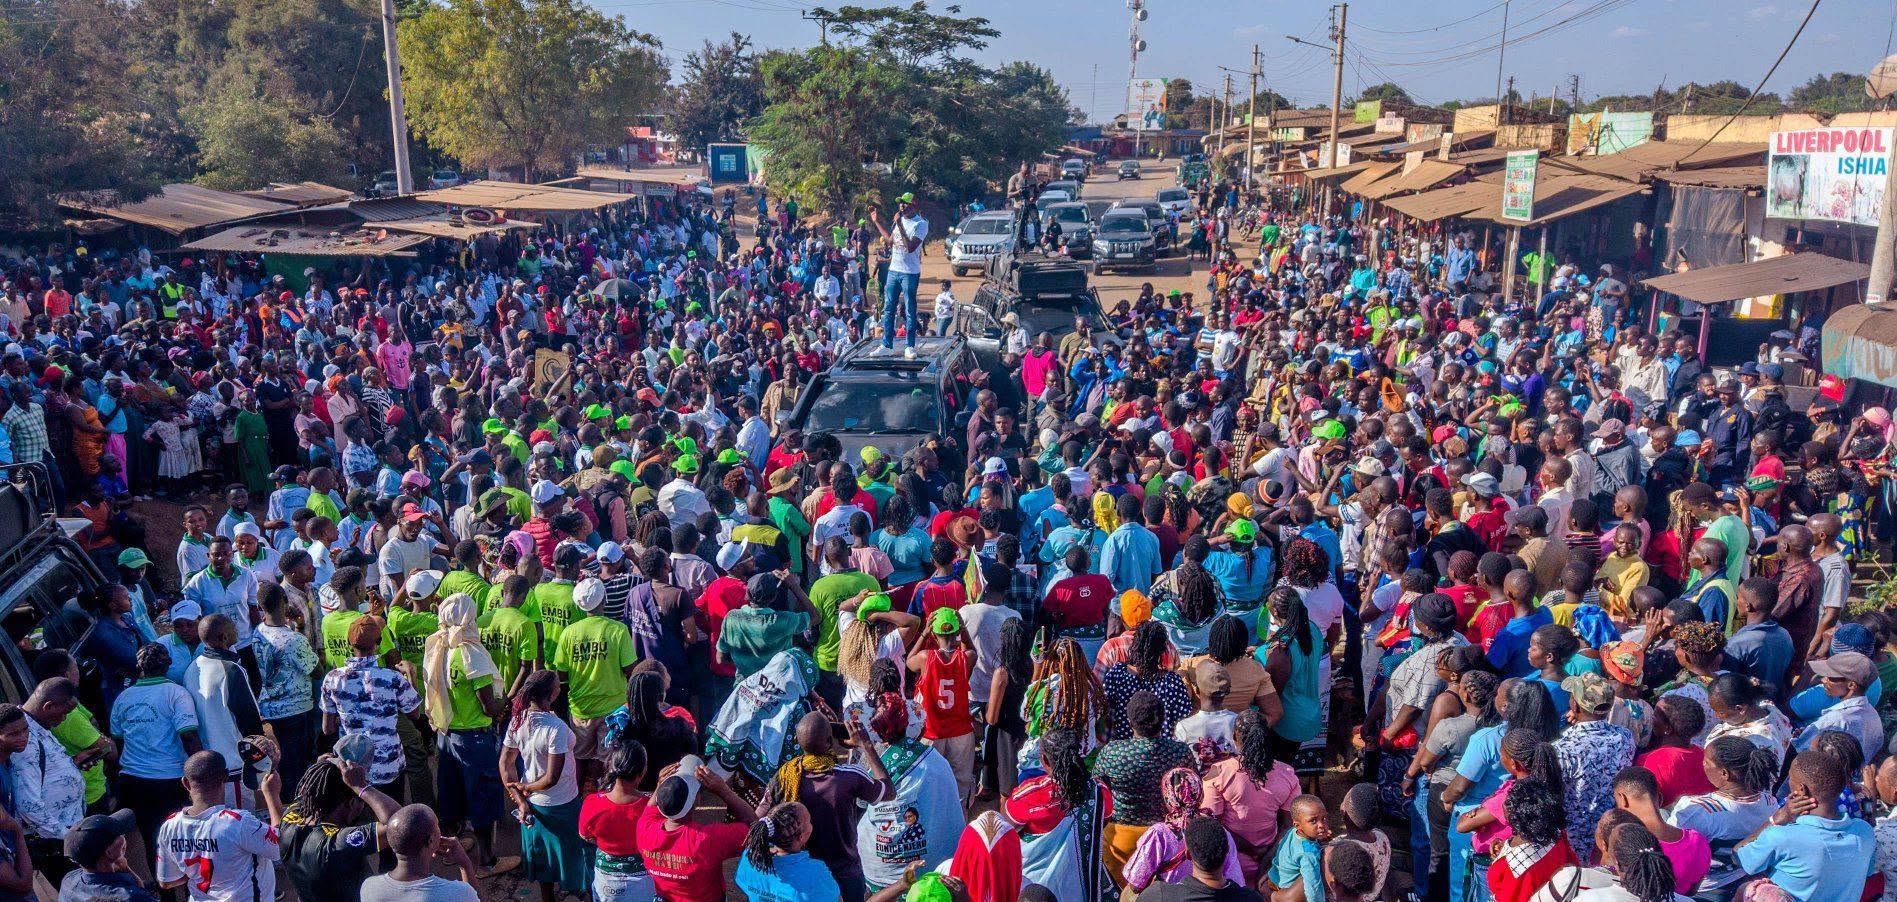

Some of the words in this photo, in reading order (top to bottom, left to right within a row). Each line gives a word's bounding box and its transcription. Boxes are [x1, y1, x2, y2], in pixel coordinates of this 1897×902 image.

[1777, 129, 1886, 153] LIVERPOOL
[1838, 157, 1886, 175] ISHIA
[542, 606, 572, 619] EMBU
[480, 633, 512, 646] EMBU
[573, 641, 607, 655] EMBU
[573, 652, 608, 663] COUNTY
[938, 679, 954, 709] 5
[171, 838, 219, 852] ROBINSON
